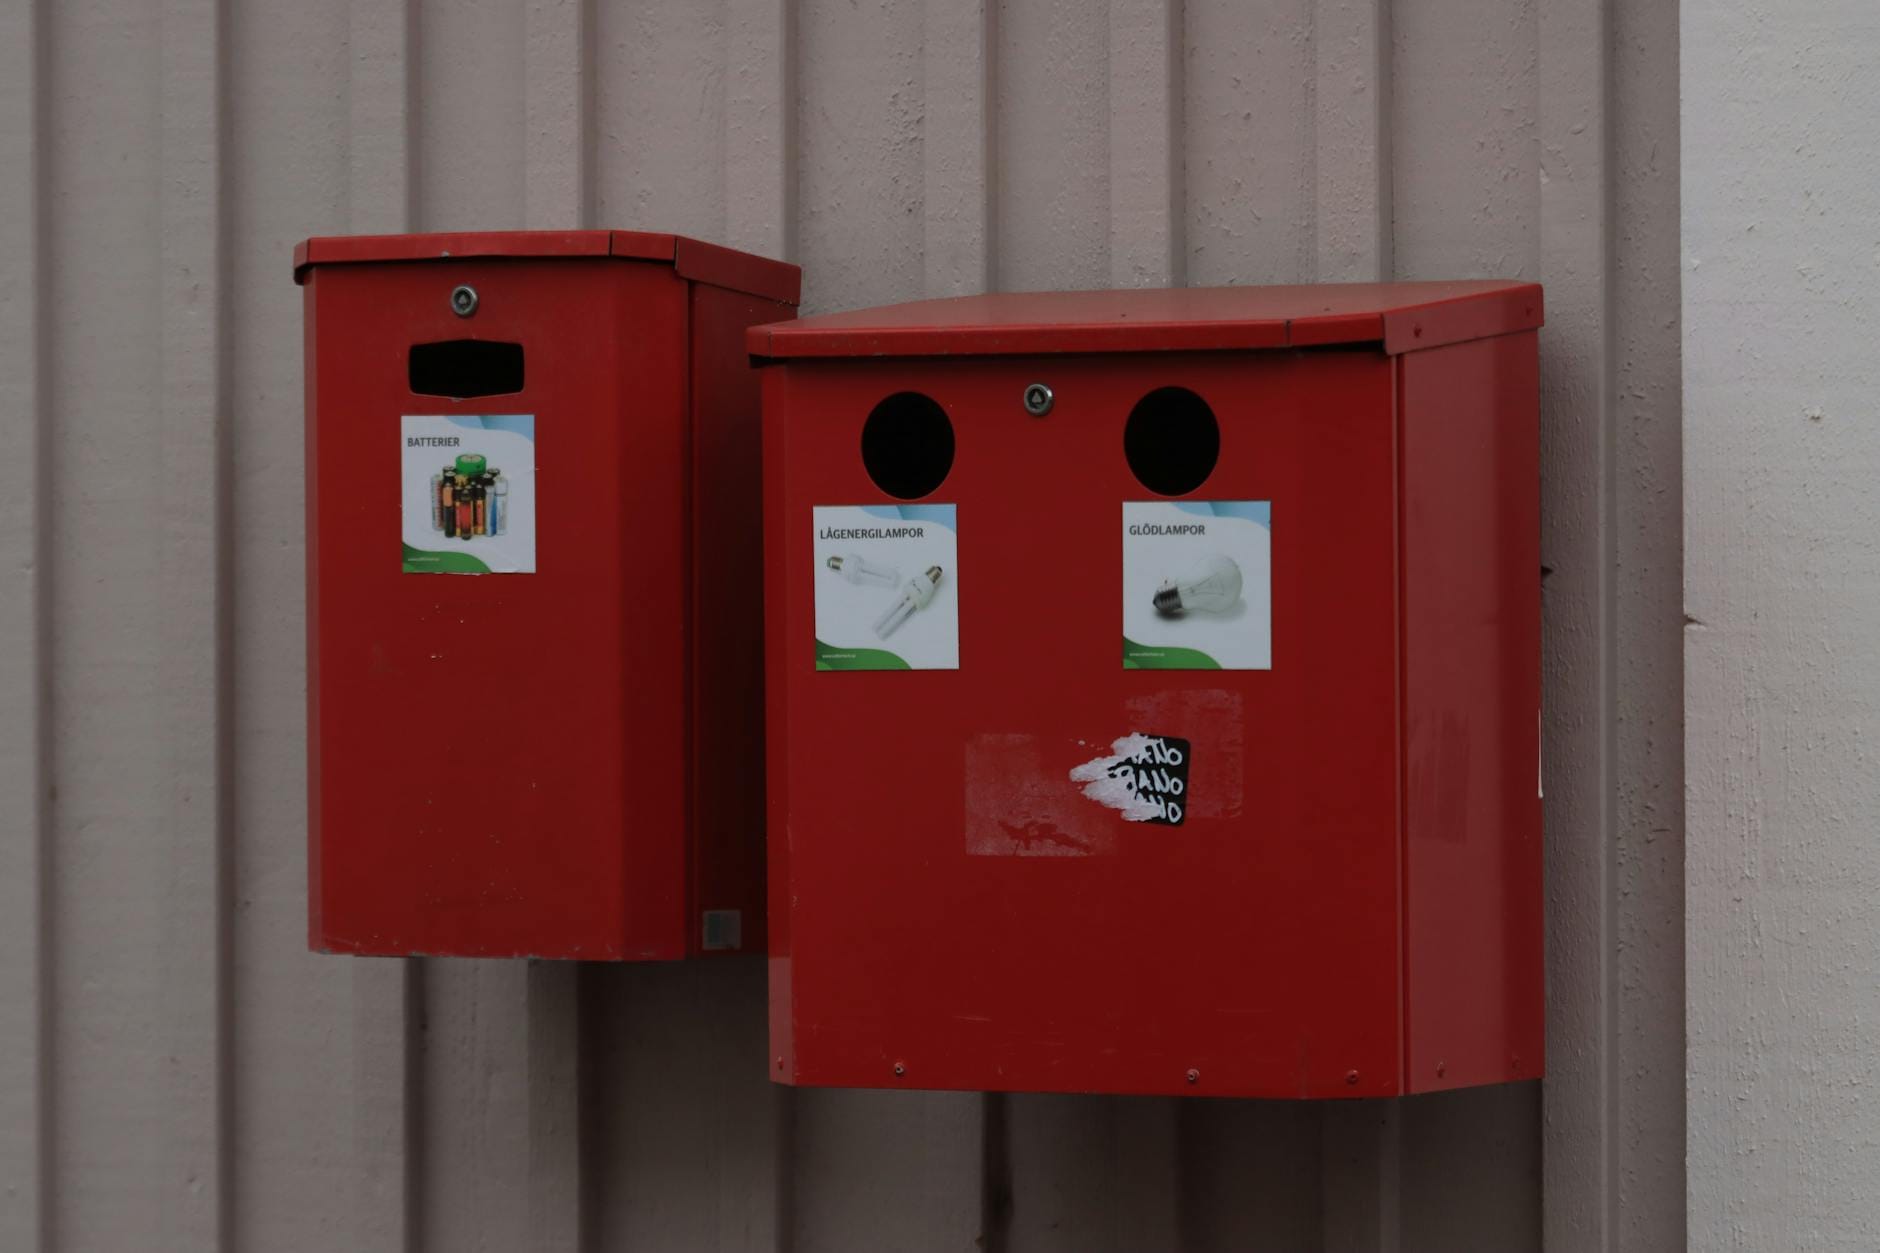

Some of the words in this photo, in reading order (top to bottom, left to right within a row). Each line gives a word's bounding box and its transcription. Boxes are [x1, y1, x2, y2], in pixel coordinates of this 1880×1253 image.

[407, 437, 460, 448] BATTERIER
[820, 526, 924, 540] LÅGENERGILAMPOR
[1129, 523, 1205, 536] GLÖDLAMPOR
